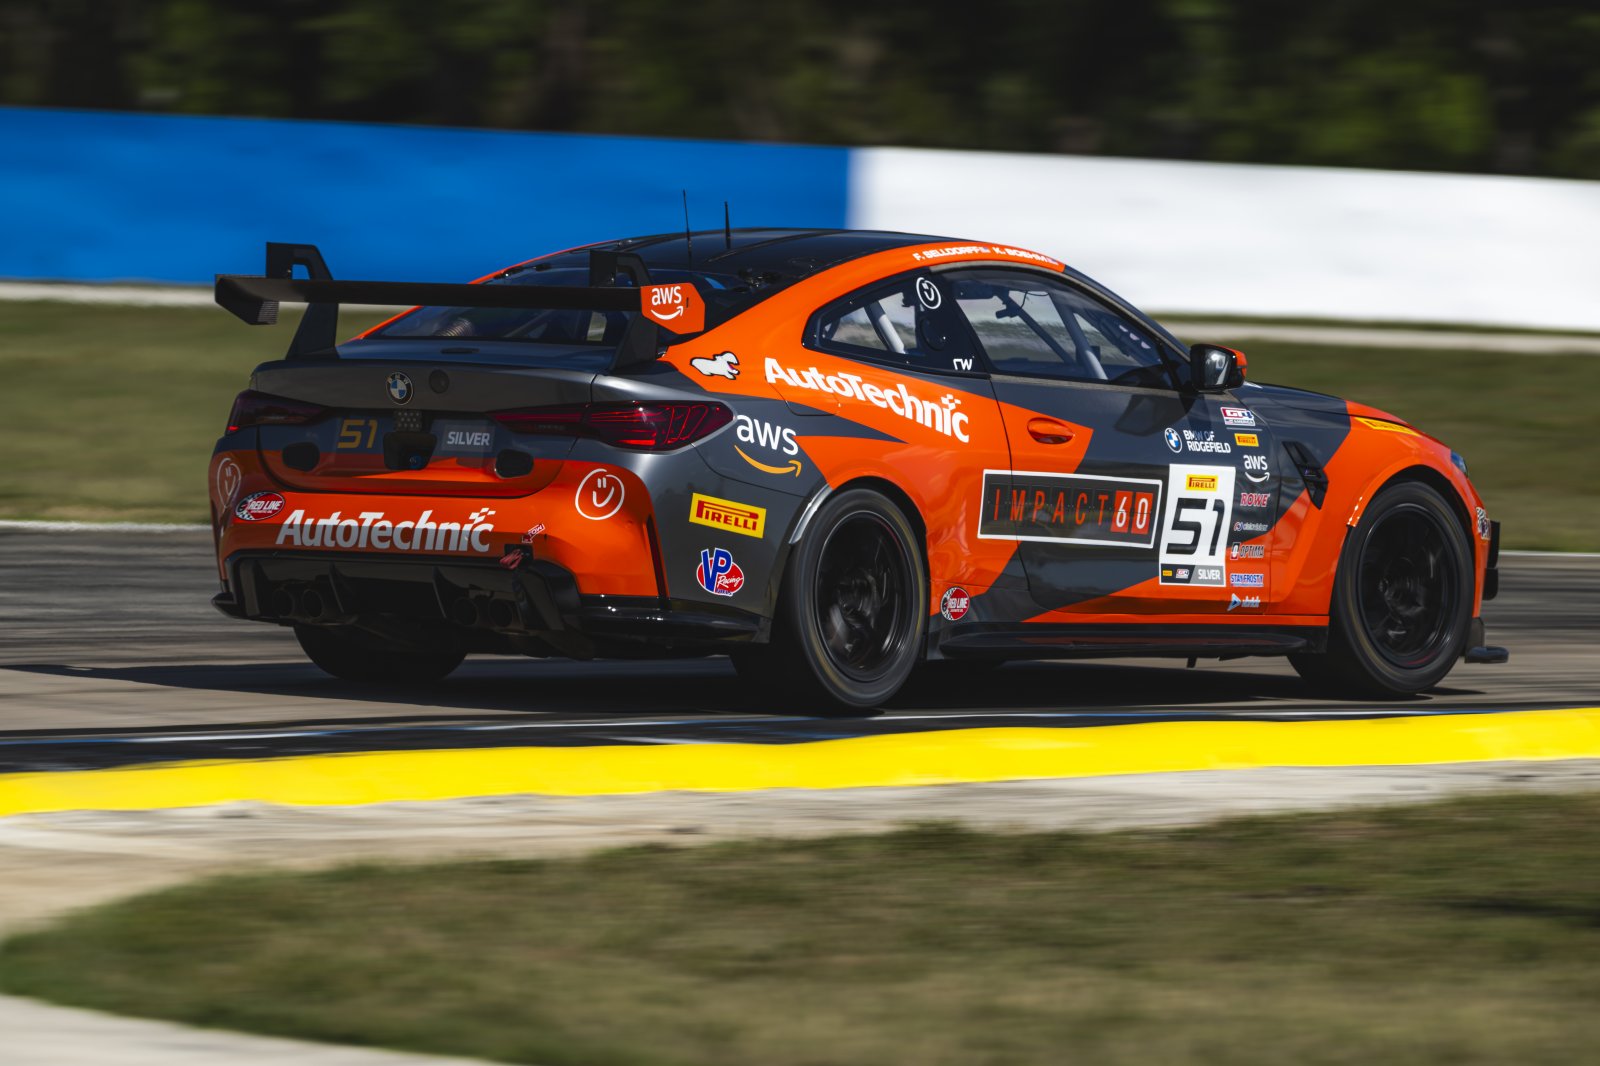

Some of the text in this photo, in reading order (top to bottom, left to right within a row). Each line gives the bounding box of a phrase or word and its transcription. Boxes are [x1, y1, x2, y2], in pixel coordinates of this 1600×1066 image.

[650, 285, 683, 307] aws
[763, 356, 970, 444] AutoTechnic
[336, 419, 379, 449] 51
[446, 430, 491, 447] SILVER
[736, 414, 799, 456] aws
[1186, 440, 1232, 454] RIDGEFIELD
[1242, 454, 1269, 471] aws
[1187, 476, 1217, 490] PIRELLI
[248, 500, 283, 511] RED LINE
[1240, 492, 1270, 508] ROWE
[695, 499, 760, 532] PIRELLI
[274, 506, 497, 553] AutoTechnic
[1165, 497, 1226, 558] 51
[1239, 544, 1265, 559] OPTIMA
[701, 547, 733, 592] VP
[1197, 568, 1221, 581] SILVER
[716, 575, 744, 589] Racing
